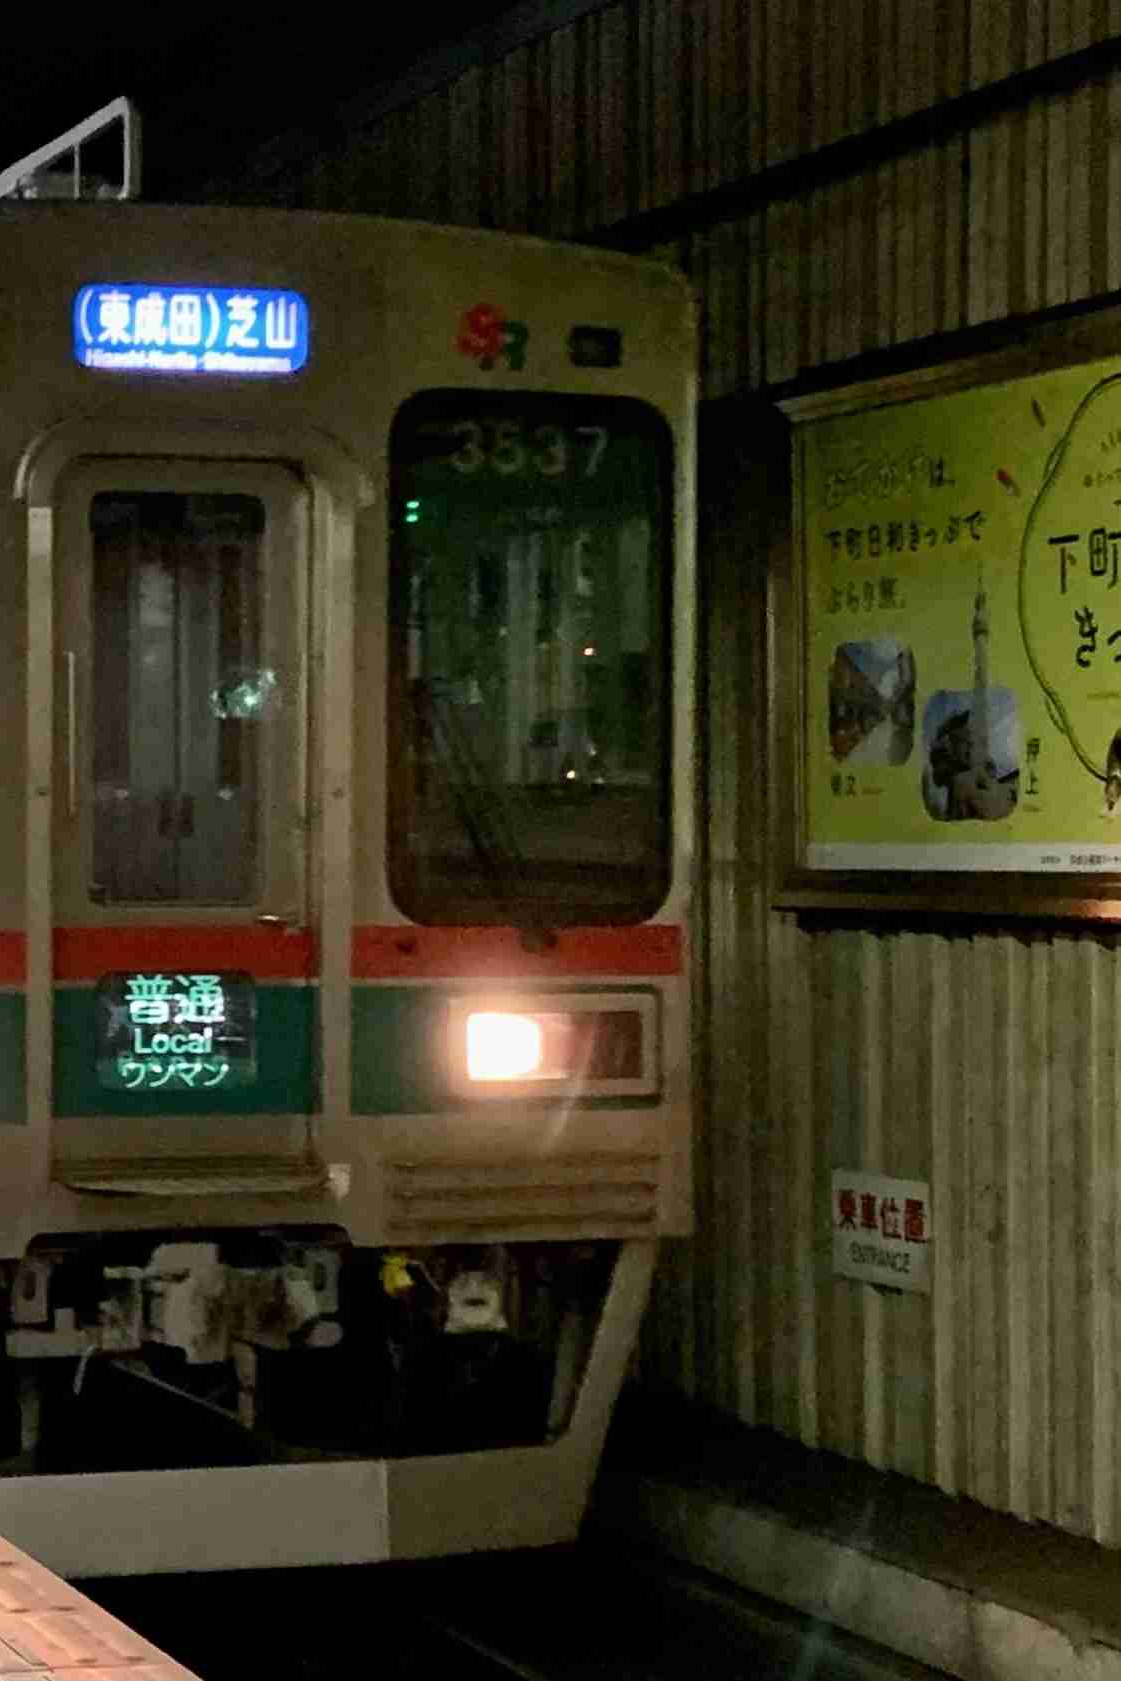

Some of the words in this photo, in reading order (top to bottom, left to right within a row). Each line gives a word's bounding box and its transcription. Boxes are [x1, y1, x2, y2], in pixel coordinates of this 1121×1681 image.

[449, 420, 610, 478] 3537
[125, 974, 226, 1024] 普通
[134, 1027, 213, 1054] Local
[120, 1061, 230, 1089] ワンマン
